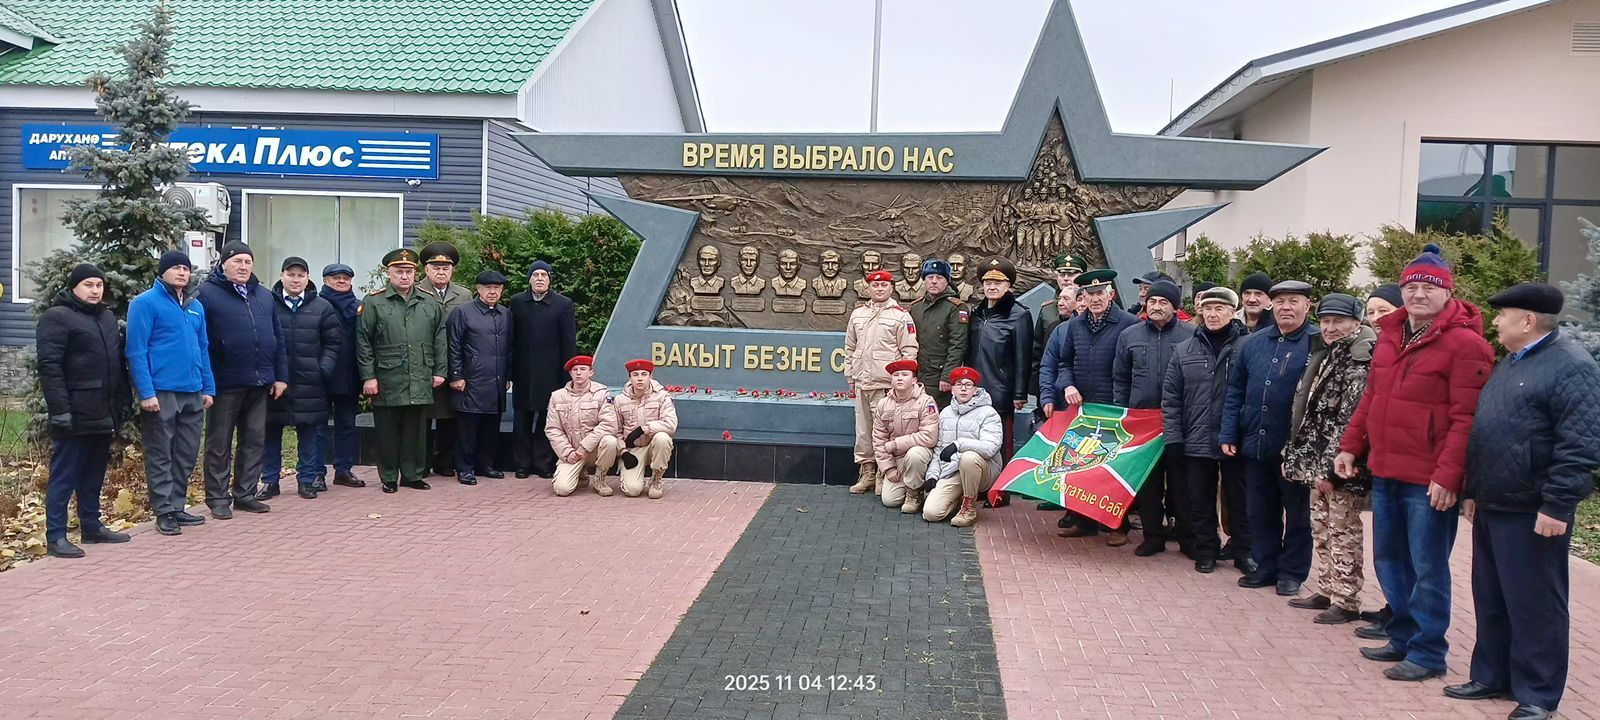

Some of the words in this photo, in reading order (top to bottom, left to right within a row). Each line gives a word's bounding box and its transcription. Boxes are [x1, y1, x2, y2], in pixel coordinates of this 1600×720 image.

[682, 142, 765, 169] ВРЕМЯ
[772, 144, 895, 172] ВЫБРАЛО
[902, 147, 955, 174] НАС
[651, 341, 736, 369] ВАКЫТ
[743, 345, 822, 373] БЕЗНЕ
[1052, 478, 1098, 506] Богатые
